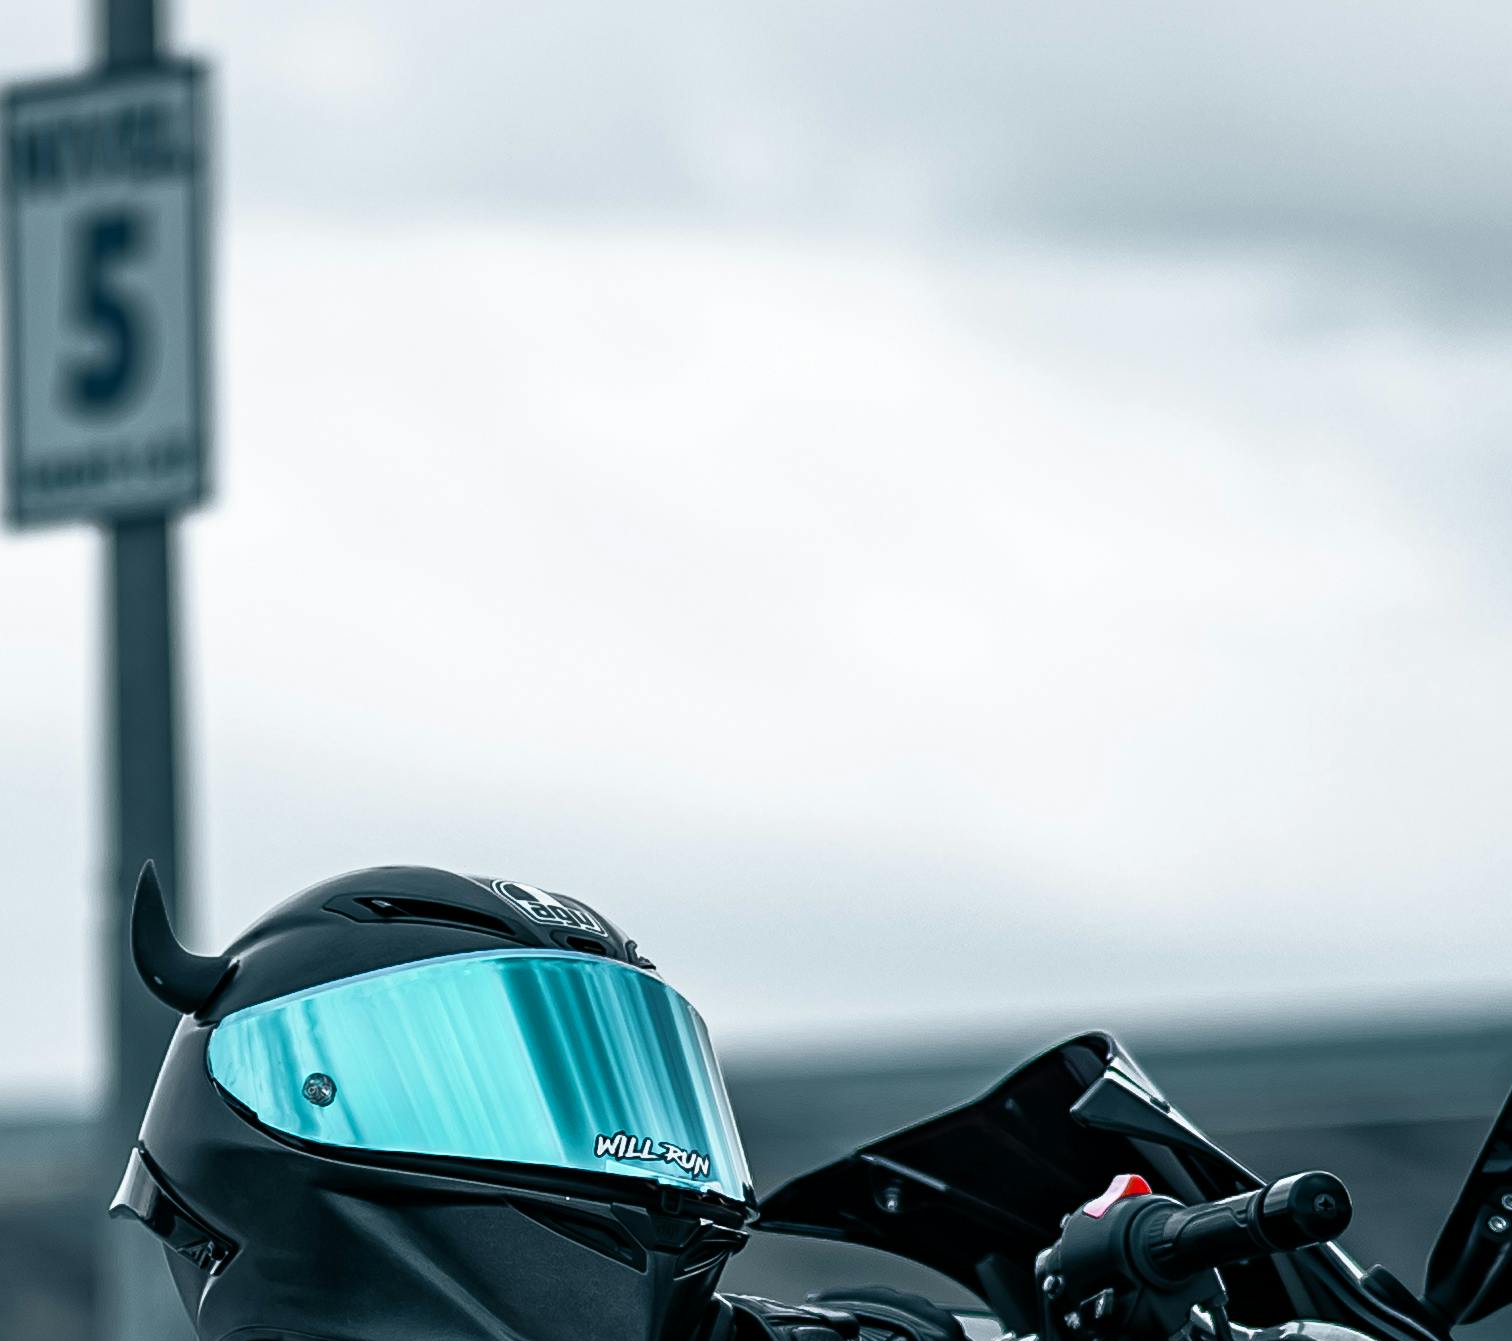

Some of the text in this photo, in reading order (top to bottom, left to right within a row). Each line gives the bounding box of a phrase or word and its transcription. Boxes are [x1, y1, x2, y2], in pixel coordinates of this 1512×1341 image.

[60, 208, 158, 420] 5
[595, 1131, 710, 1177] WILL RUN
